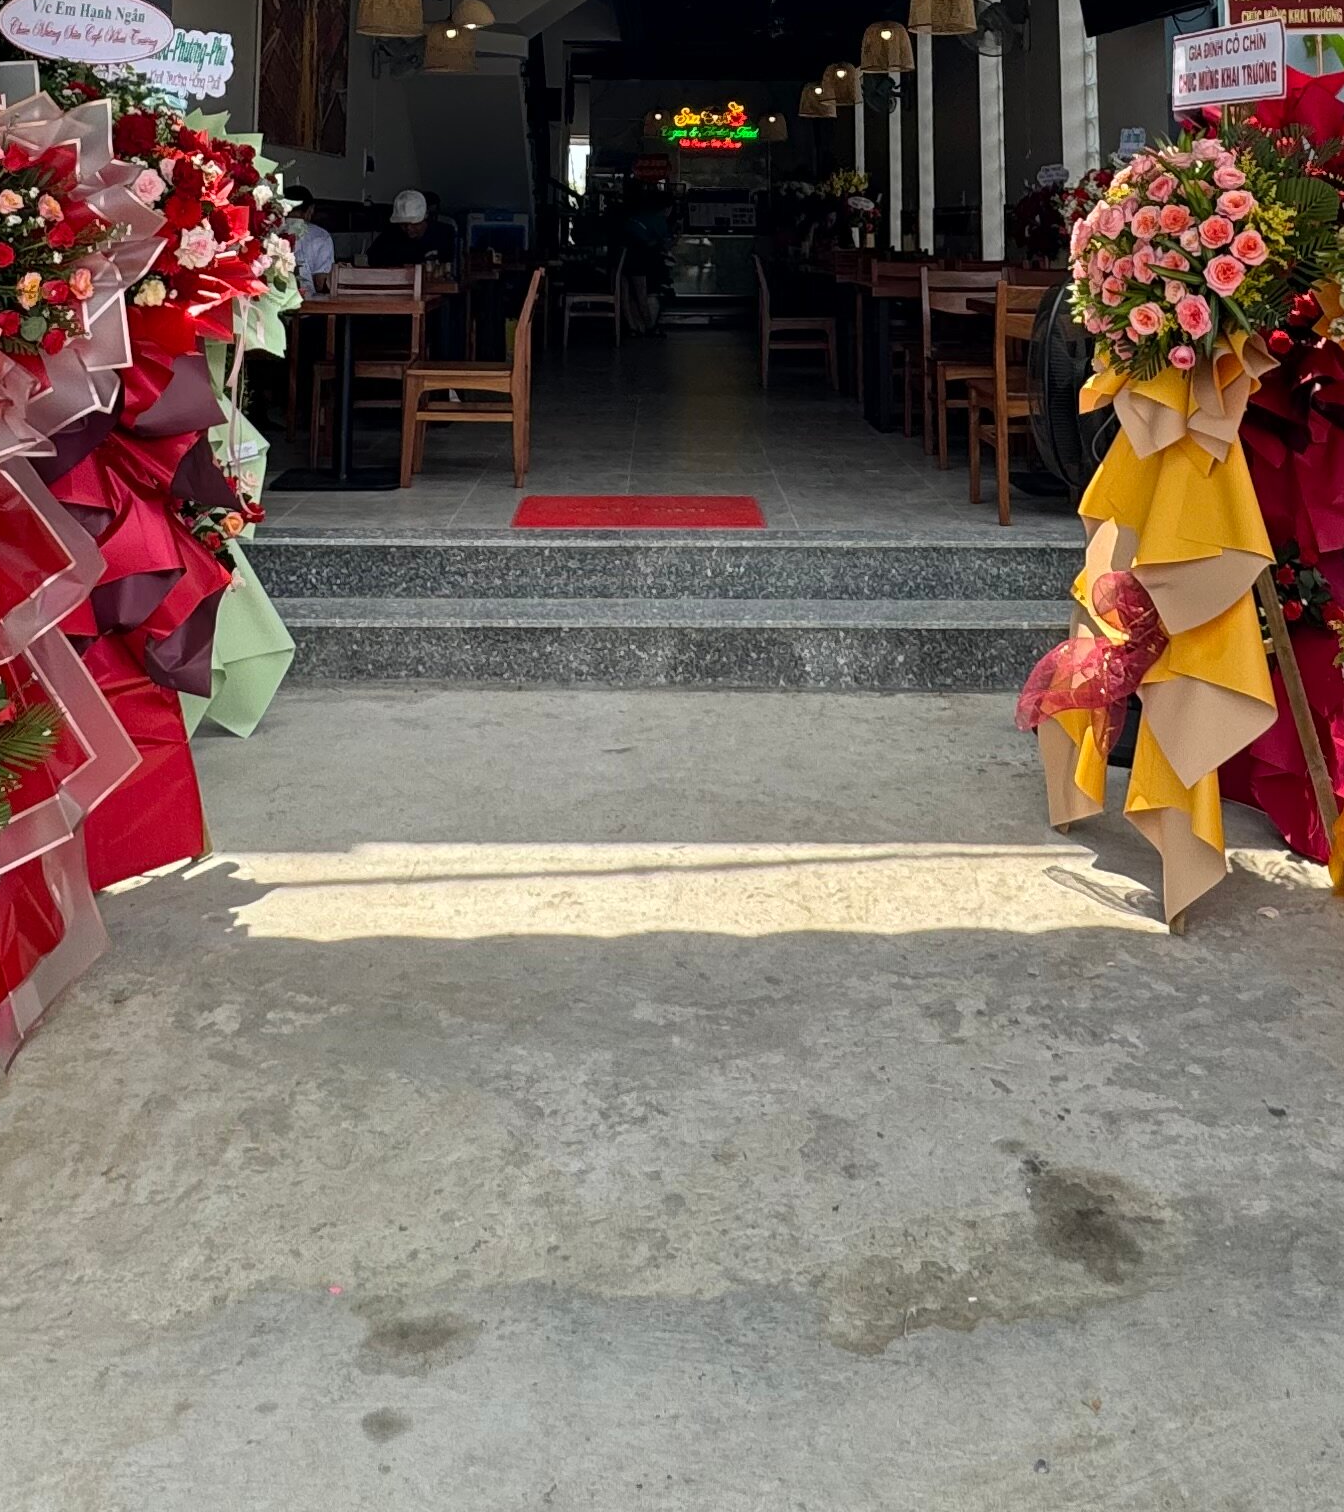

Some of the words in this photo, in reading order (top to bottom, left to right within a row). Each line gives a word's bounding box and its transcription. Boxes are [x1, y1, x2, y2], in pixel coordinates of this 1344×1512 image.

[33, 0, 52, 13] V/c
[56, 1, 75, 16] Em
[80, 4, 111, 22] Hạnh
[117, 7, 145, 25] Ngân
[1288, 9, 1308, 23] KHAI
[1189, 46, 1202, 61] GIA
[1222, 66, 1239, 87] KHAI
